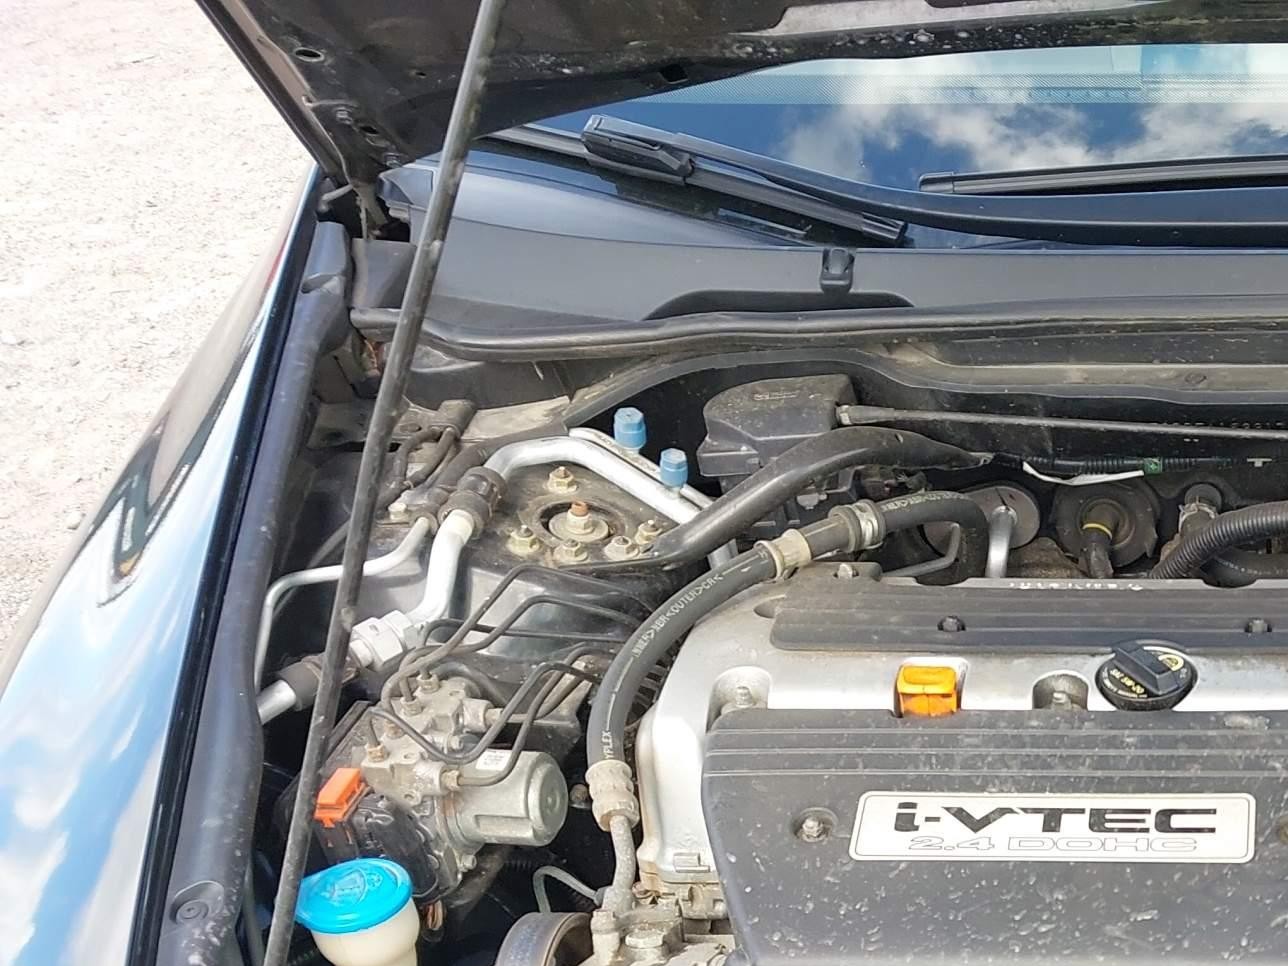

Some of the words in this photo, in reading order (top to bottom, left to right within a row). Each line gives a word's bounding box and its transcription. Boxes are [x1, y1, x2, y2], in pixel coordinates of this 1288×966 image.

[894, 801, 1217, 834] i-VTEC
[909, 836, 996, 851] 2.4
[1007, 836, 1198, 852] DOHC
